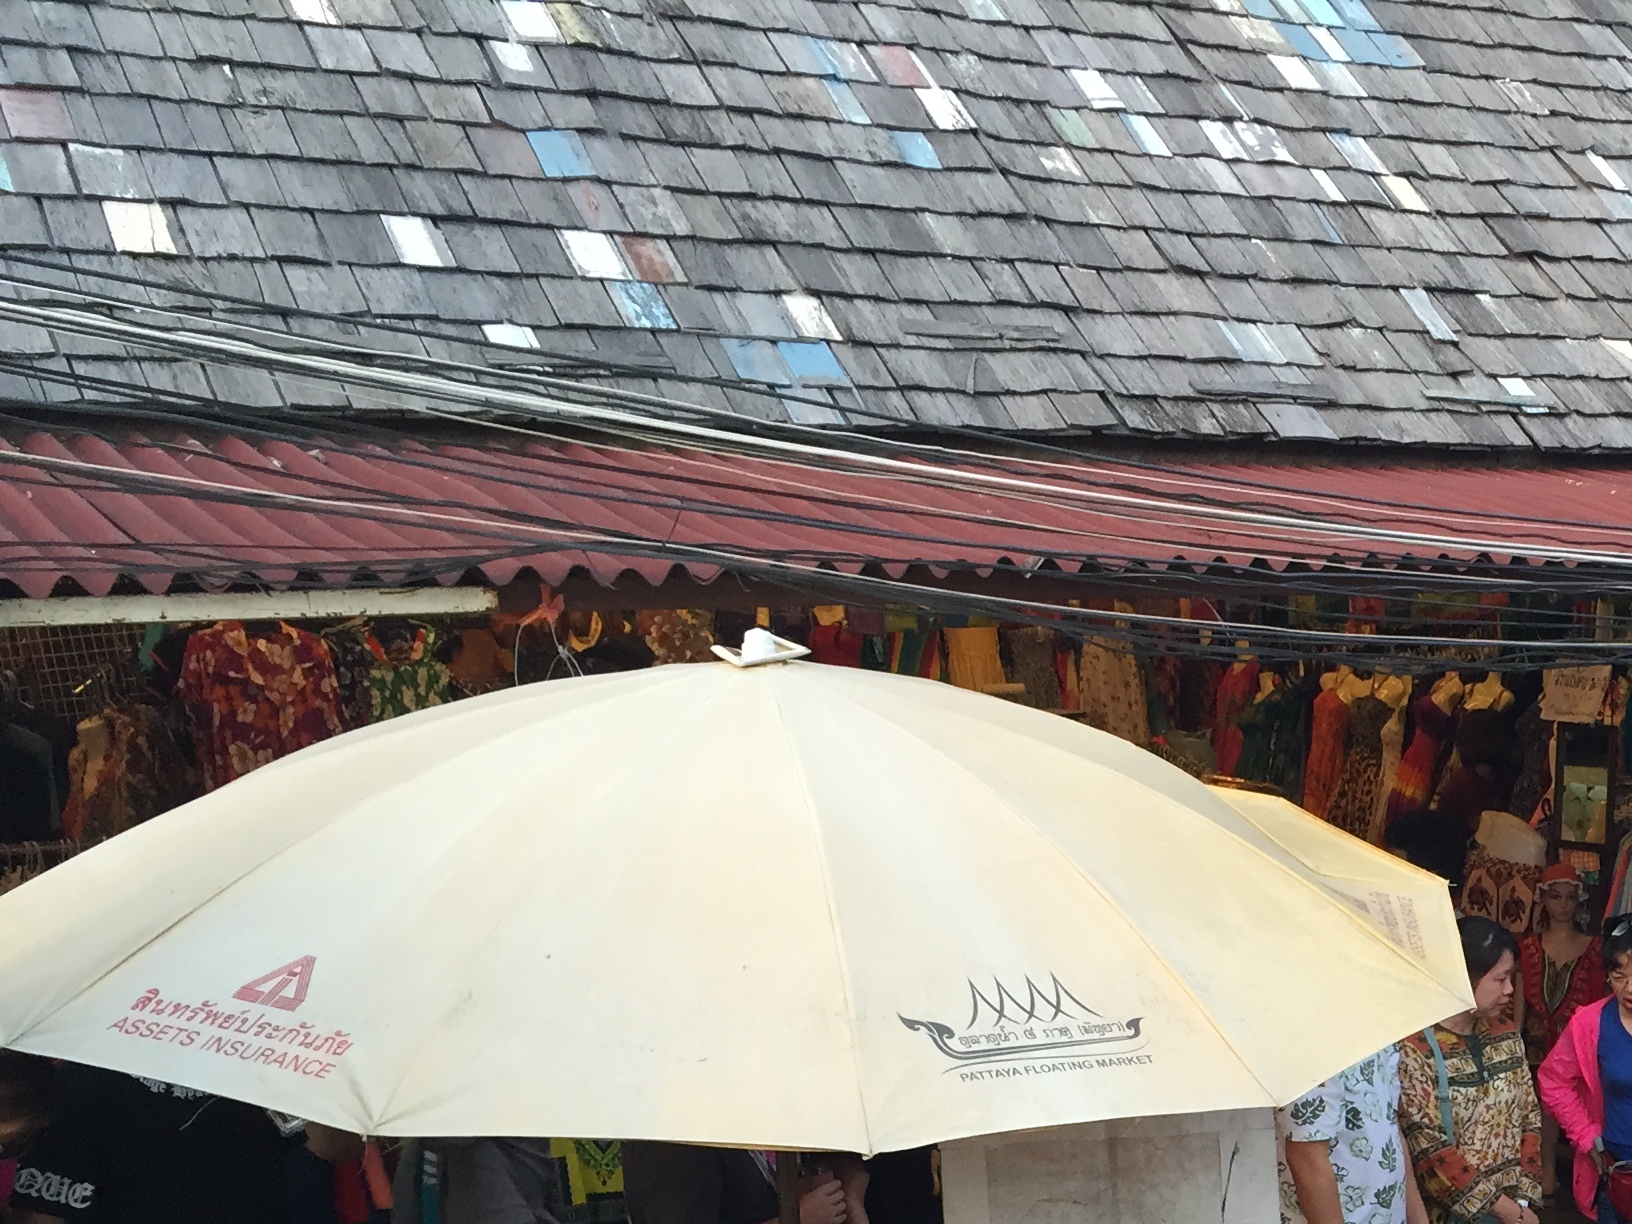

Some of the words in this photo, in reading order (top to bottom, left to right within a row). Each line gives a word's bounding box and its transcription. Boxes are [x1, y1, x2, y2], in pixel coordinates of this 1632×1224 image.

[107, 1016, 201, 1047] ASSETS
[200, 1034, 338, 1080] INSURANCE
[130, 987, 355, 1056] สินทรัพย์ประกันภัย
[959, 1067, 1022, 1083] PATTAYA
[1024, 1060, 1094, 1076] FLOATING
[1095, 1054, 1154, 1069] MARKET
